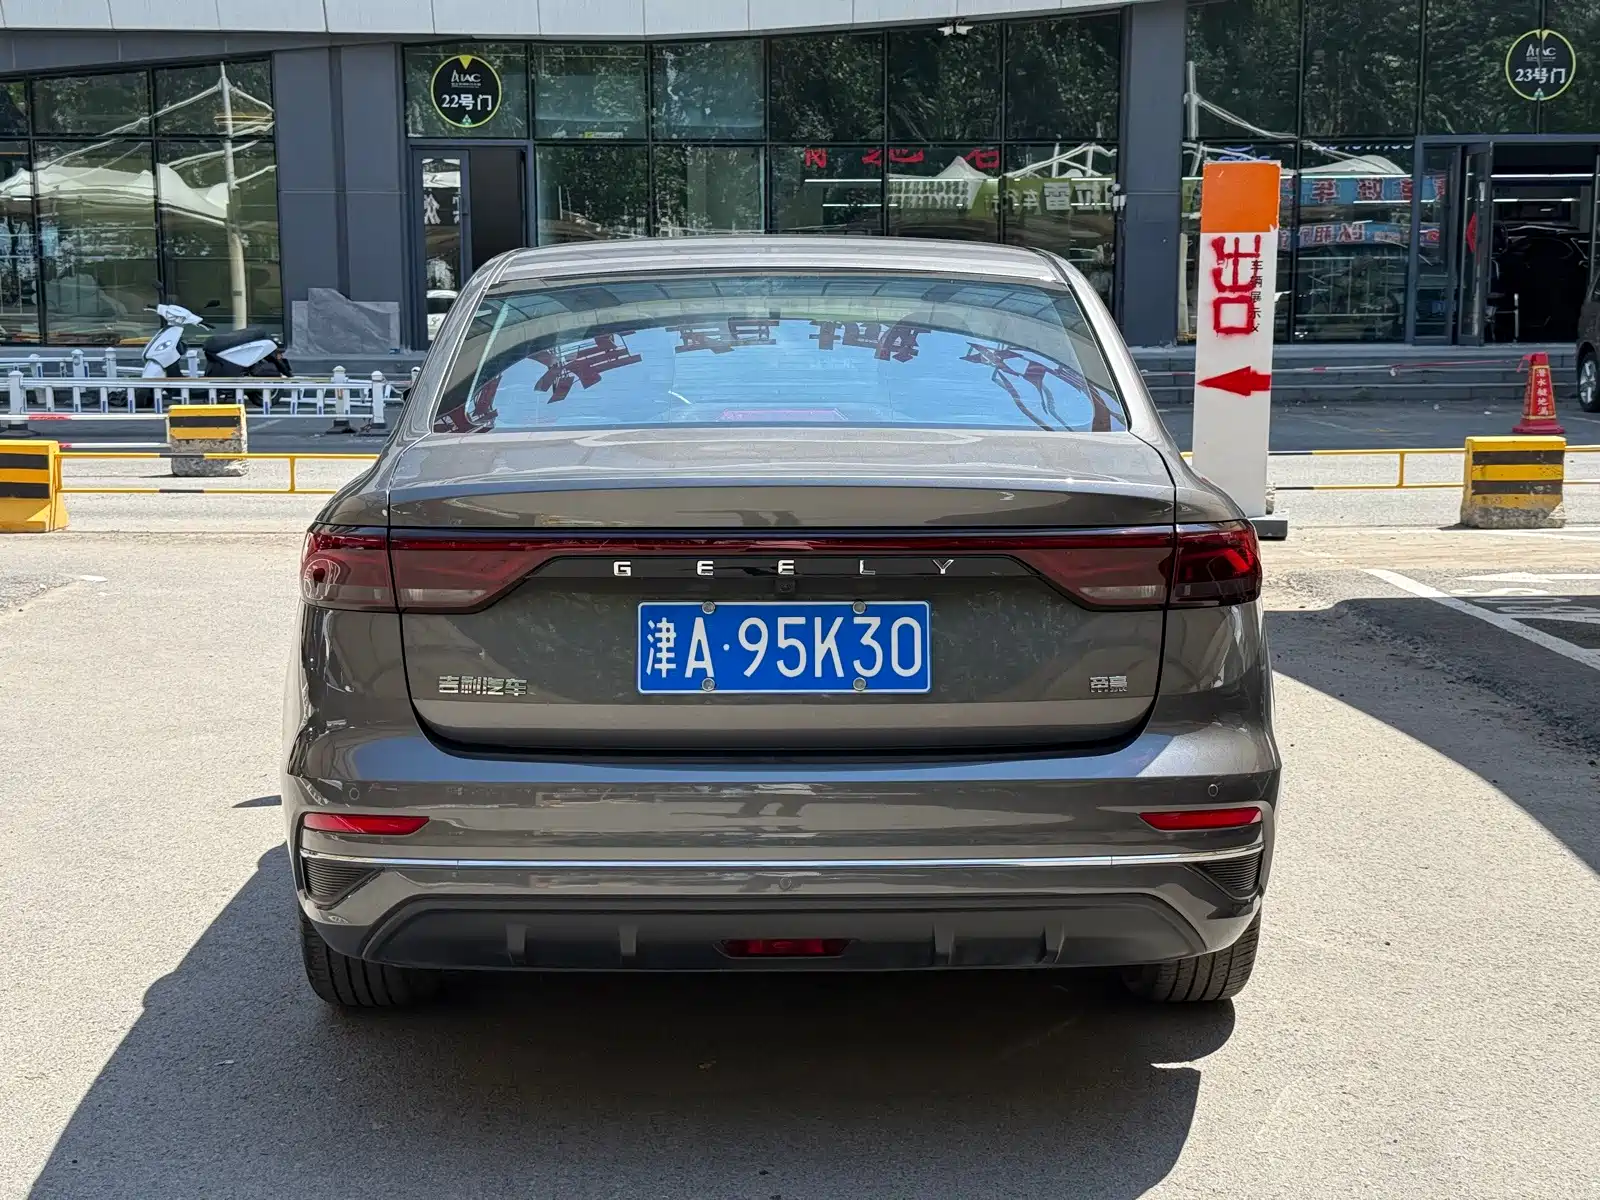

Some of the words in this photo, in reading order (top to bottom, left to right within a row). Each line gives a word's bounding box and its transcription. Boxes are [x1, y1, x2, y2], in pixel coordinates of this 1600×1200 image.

[1515, 67, 1566, 83] 23号门
[441, 94, 492, 111] 22号门
[1210, 234, 1261, 334] 出口
[613, 559, 954, 577] GEELY
[438, 675, 528, 697] 吉利汽车
